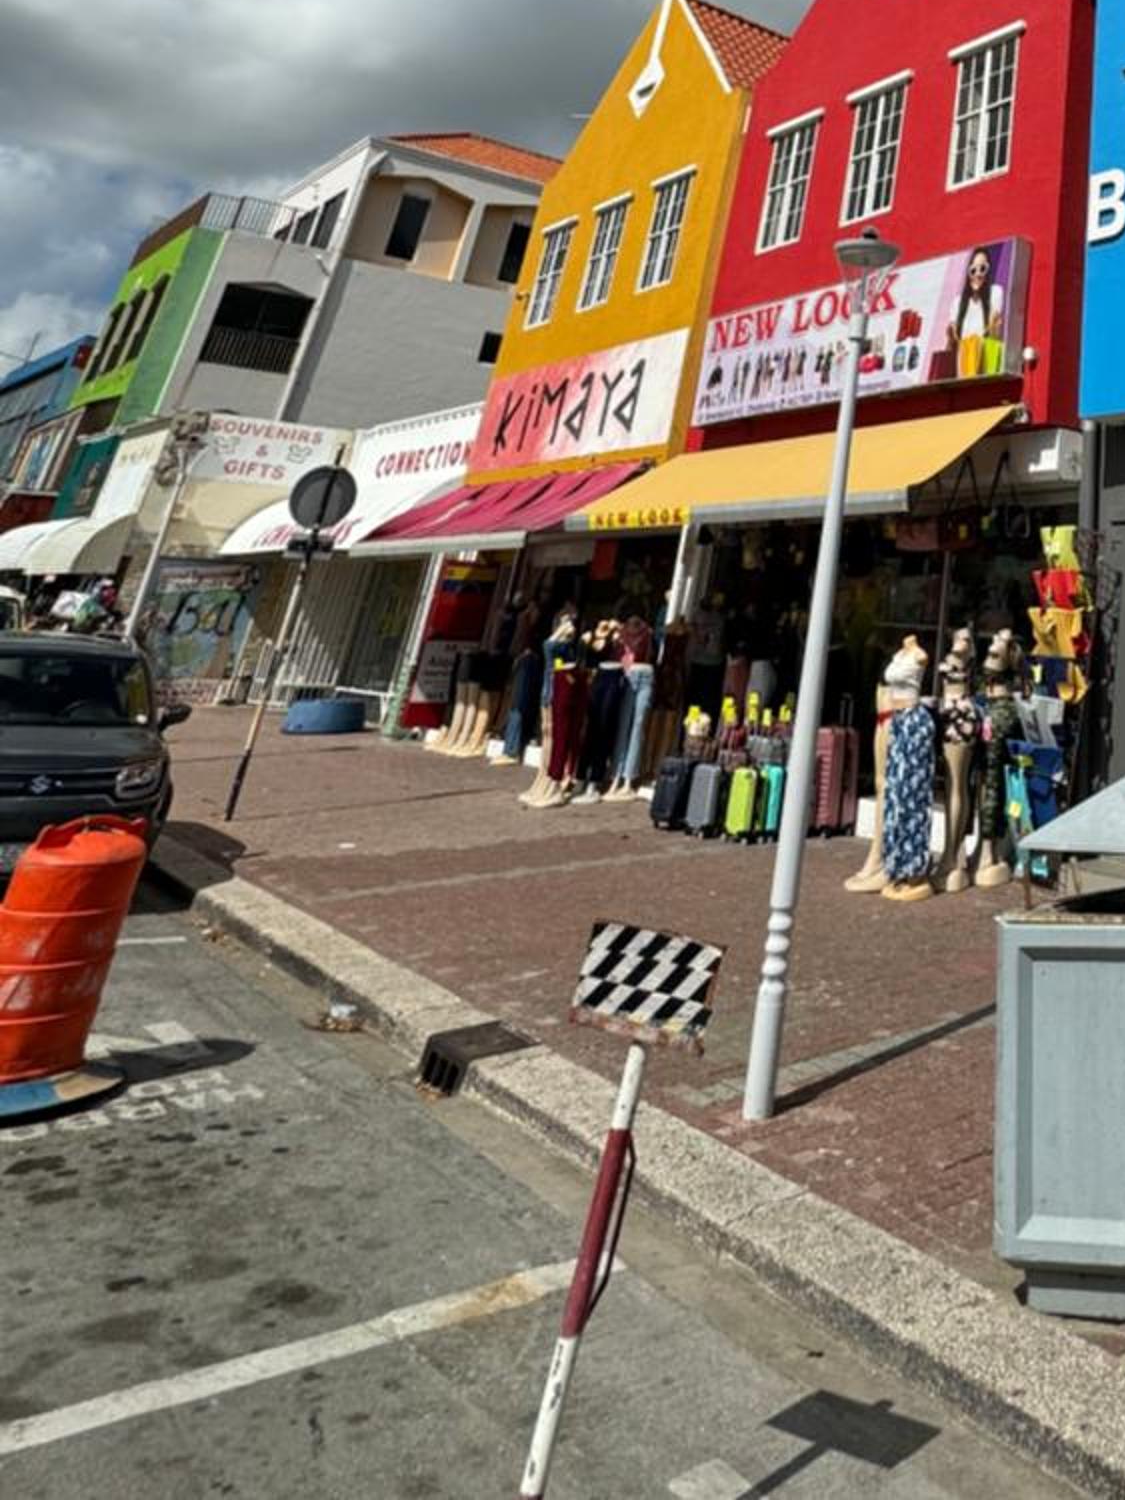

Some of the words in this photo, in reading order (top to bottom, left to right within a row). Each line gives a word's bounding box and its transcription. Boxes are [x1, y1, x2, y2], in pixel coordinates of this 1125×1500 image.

[711, 305, 783, 353] NEW
[211, 418, 324, 446] SOUVENIRS
[256, 446, 269, 458] &
[223, 459, 287, 481] GIFTS
